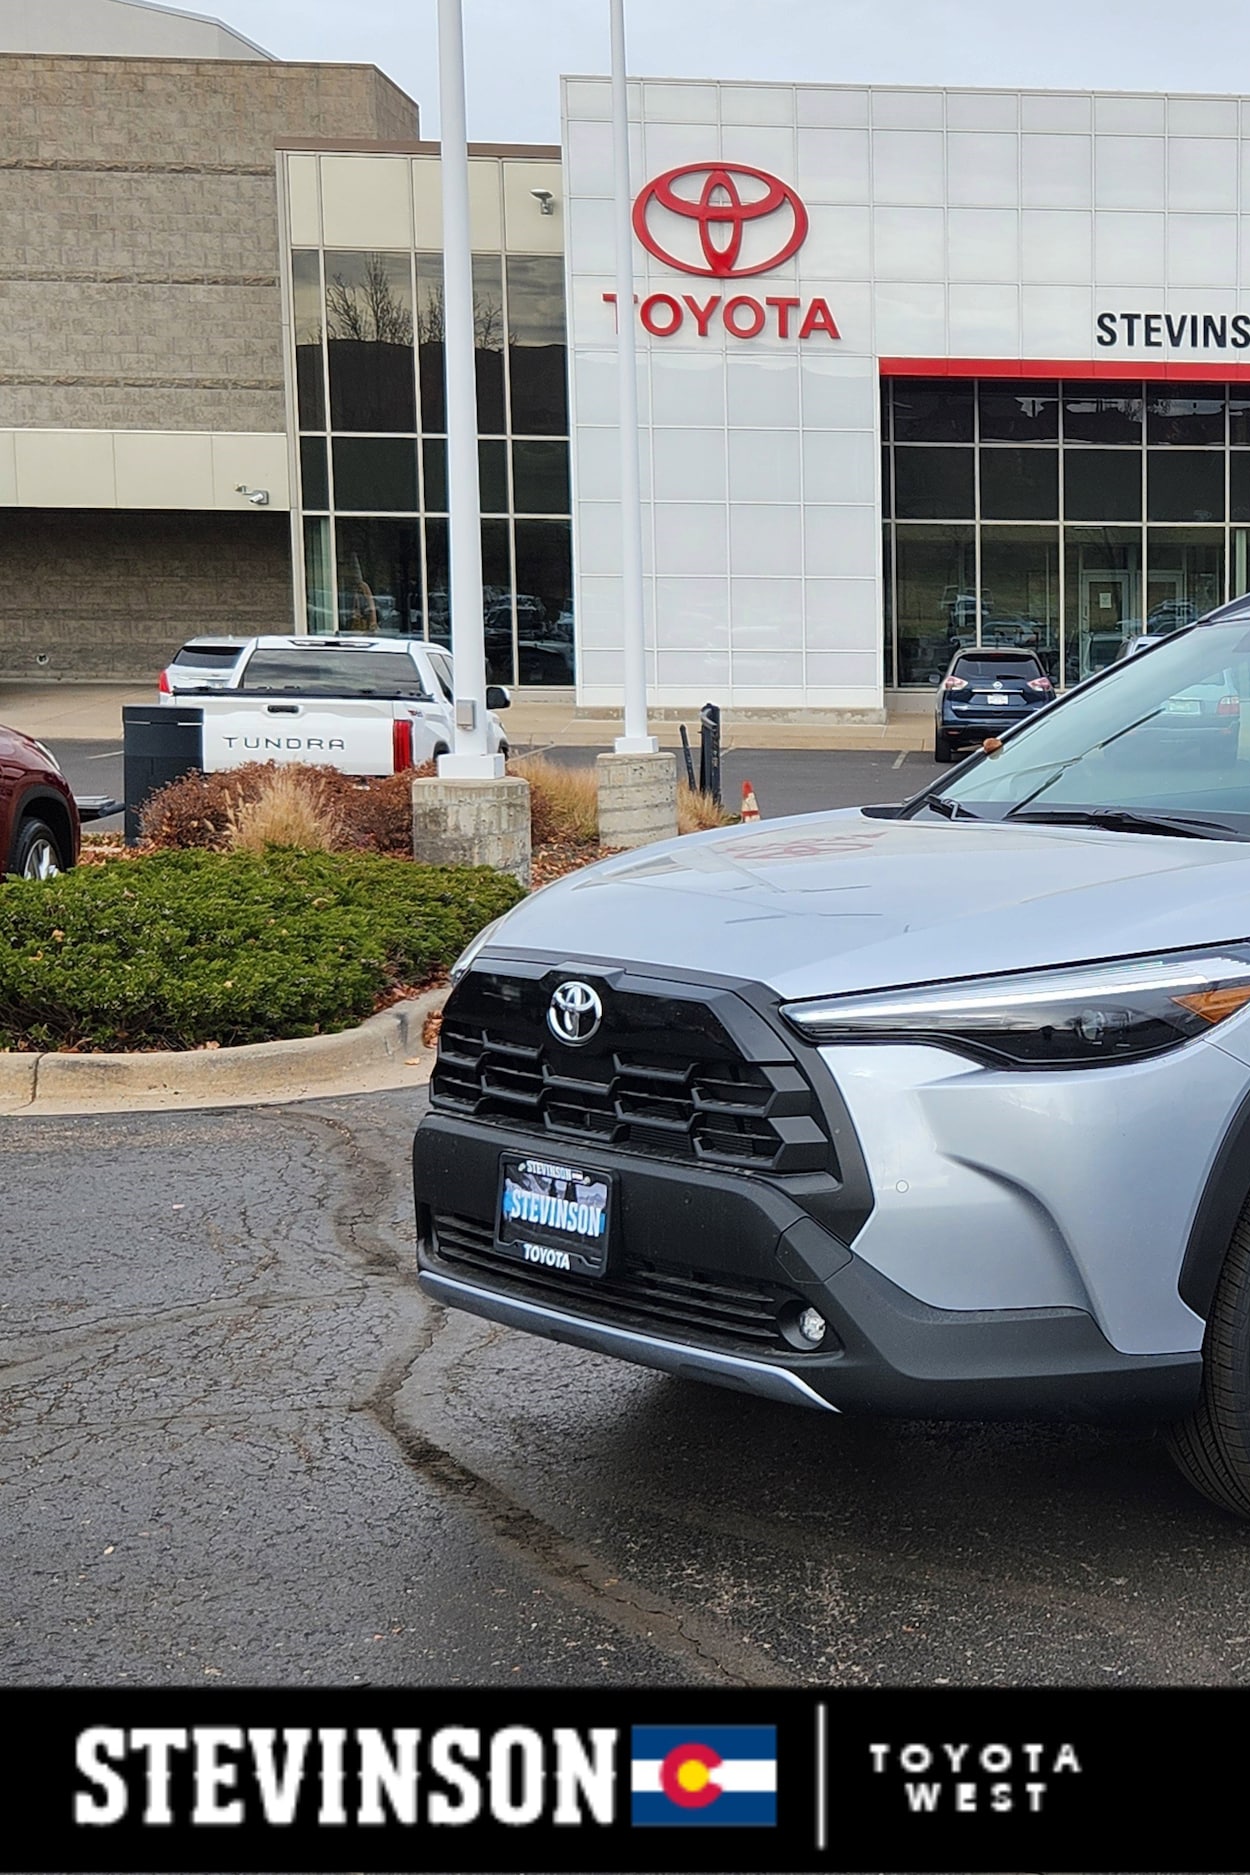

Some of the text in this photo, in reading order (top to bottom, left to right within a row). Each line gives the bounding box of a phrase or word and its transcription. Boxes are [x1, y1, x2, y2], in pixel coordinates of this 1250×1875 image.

[223, 736, 346, 751] TUNDRA
[526, 1160, 572, 1181] STEVINSON
[511, 1188, 602, 1237] STEVINSON
[523, 1243, 571, 1270] TOYOTA
